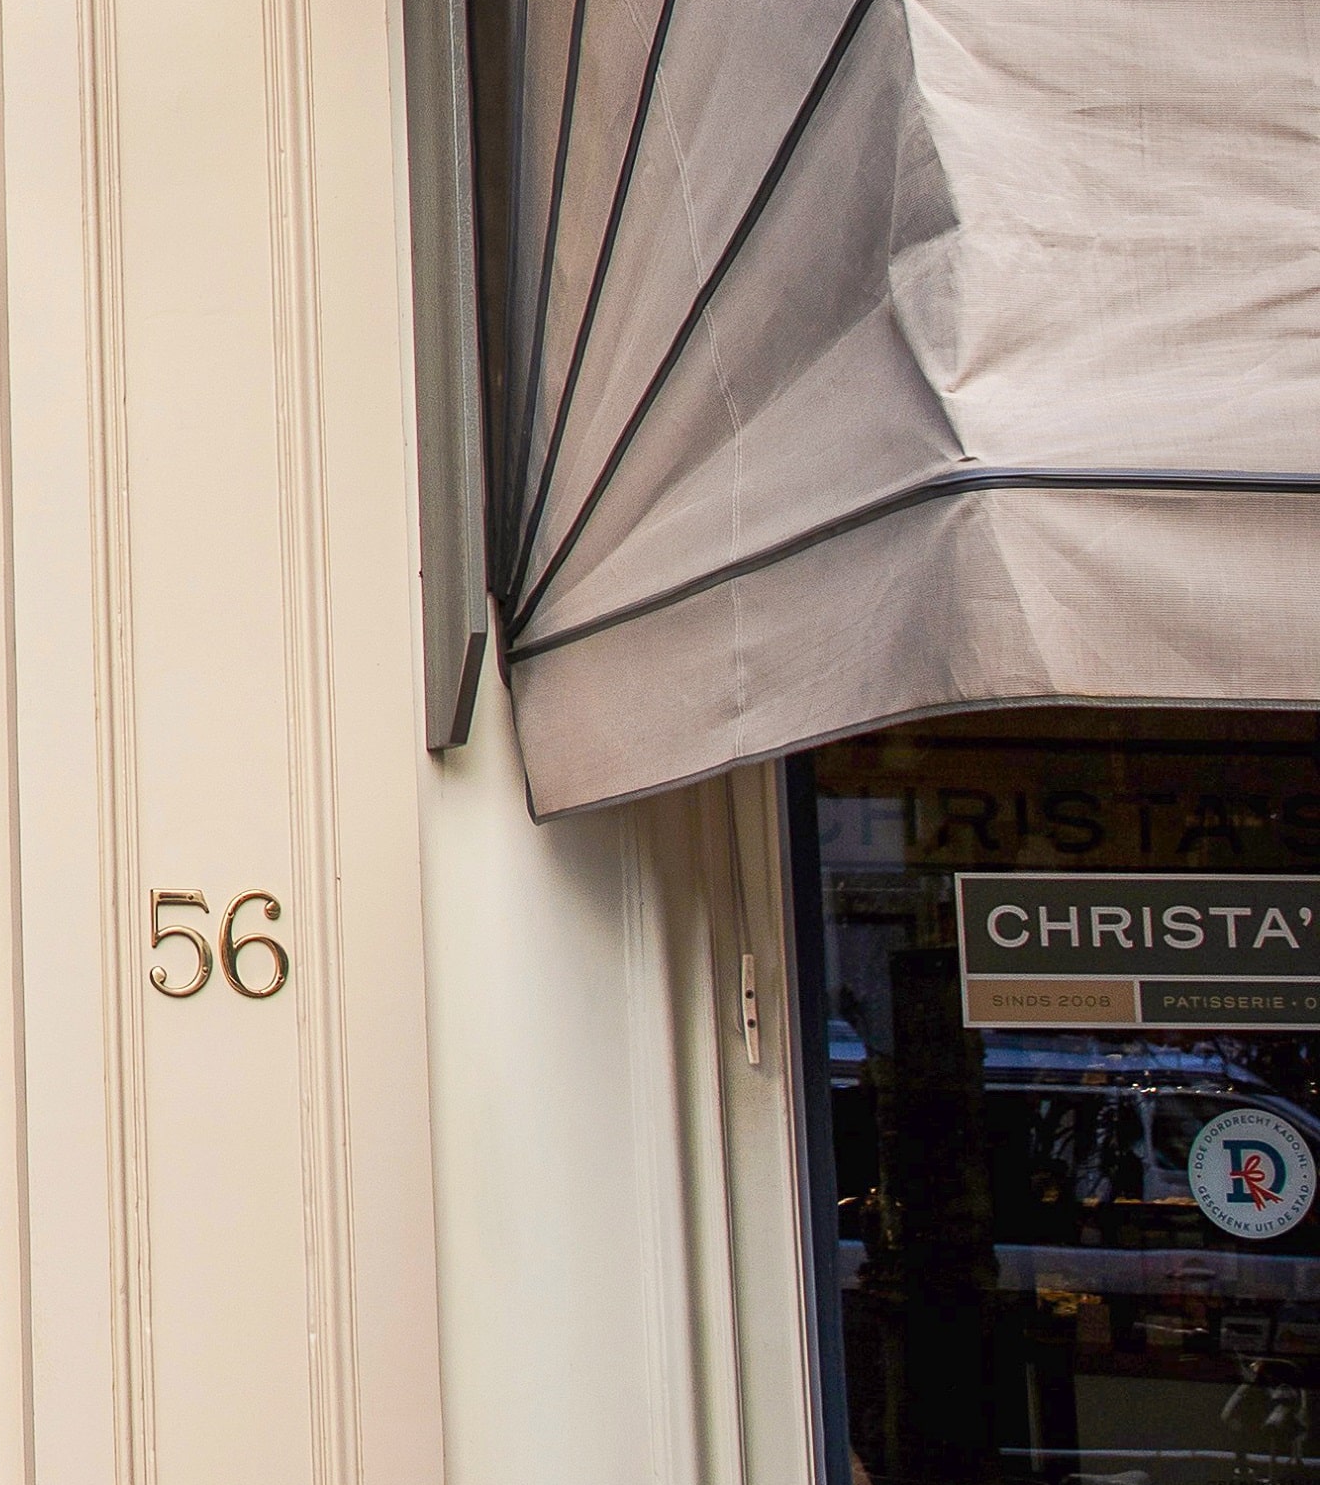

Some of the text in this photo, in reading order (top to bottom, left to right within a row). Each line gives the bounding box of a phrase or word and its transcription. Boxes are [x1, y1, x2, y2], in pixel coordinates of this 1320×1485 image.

[149, 888, 290, 998] 56
[992, 995, 1111, 1008] SINDS 2008
[1163, 995, 1285, 1010] PATISSERIE
[1204, 1115, 1271, 1144] DORDRECHT
[1198, 1185, 1309, 1232] GESCHENK UIT DE STAD
